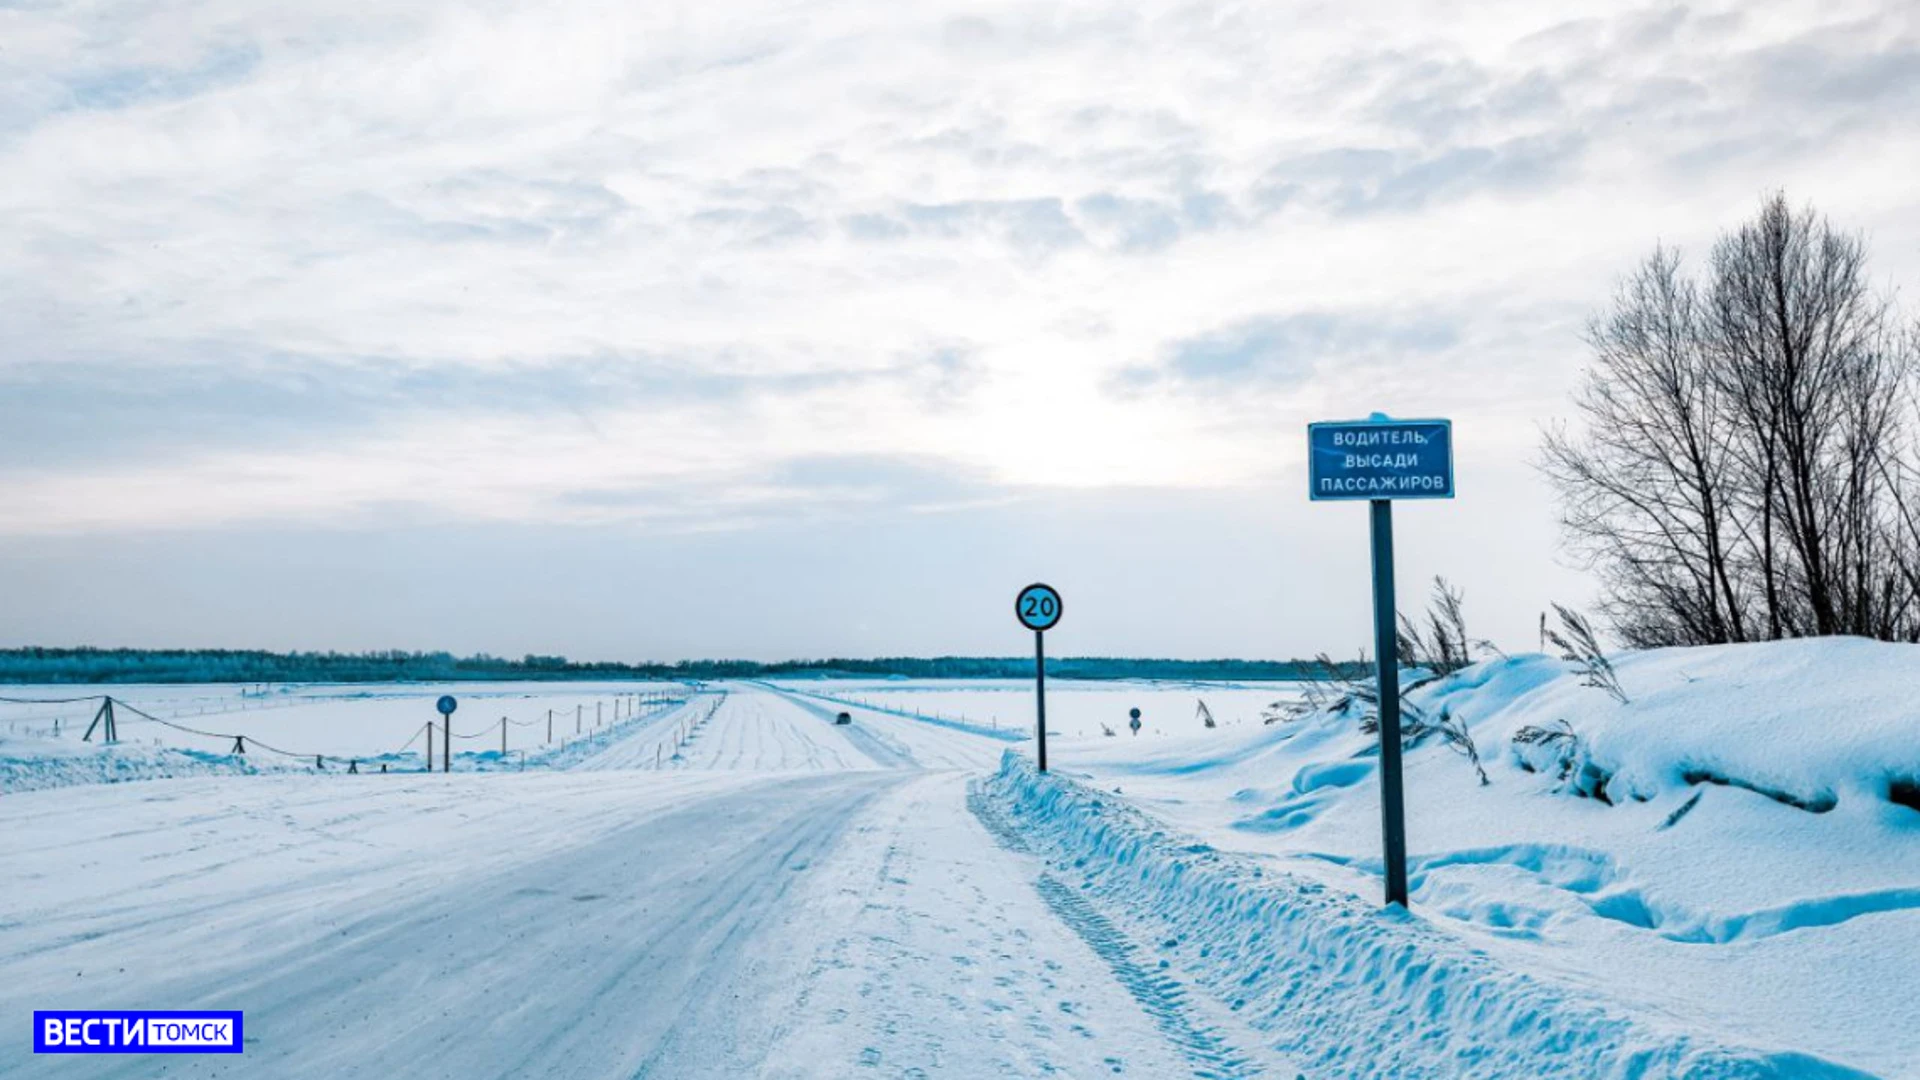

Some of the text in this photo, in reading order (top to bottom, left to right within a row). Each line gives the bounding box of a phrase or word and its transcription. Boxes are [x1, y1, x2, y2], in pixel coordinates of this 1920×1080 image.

[1333, 431, 1428, 446] ВОДИТЕЛЬ,
[1345, 454, 1418, 468] ВЫСАДИ
[1321, 476, 1444, 491] ПАССАЖИРОВ
[1024, 596, 1054, 617] 20
